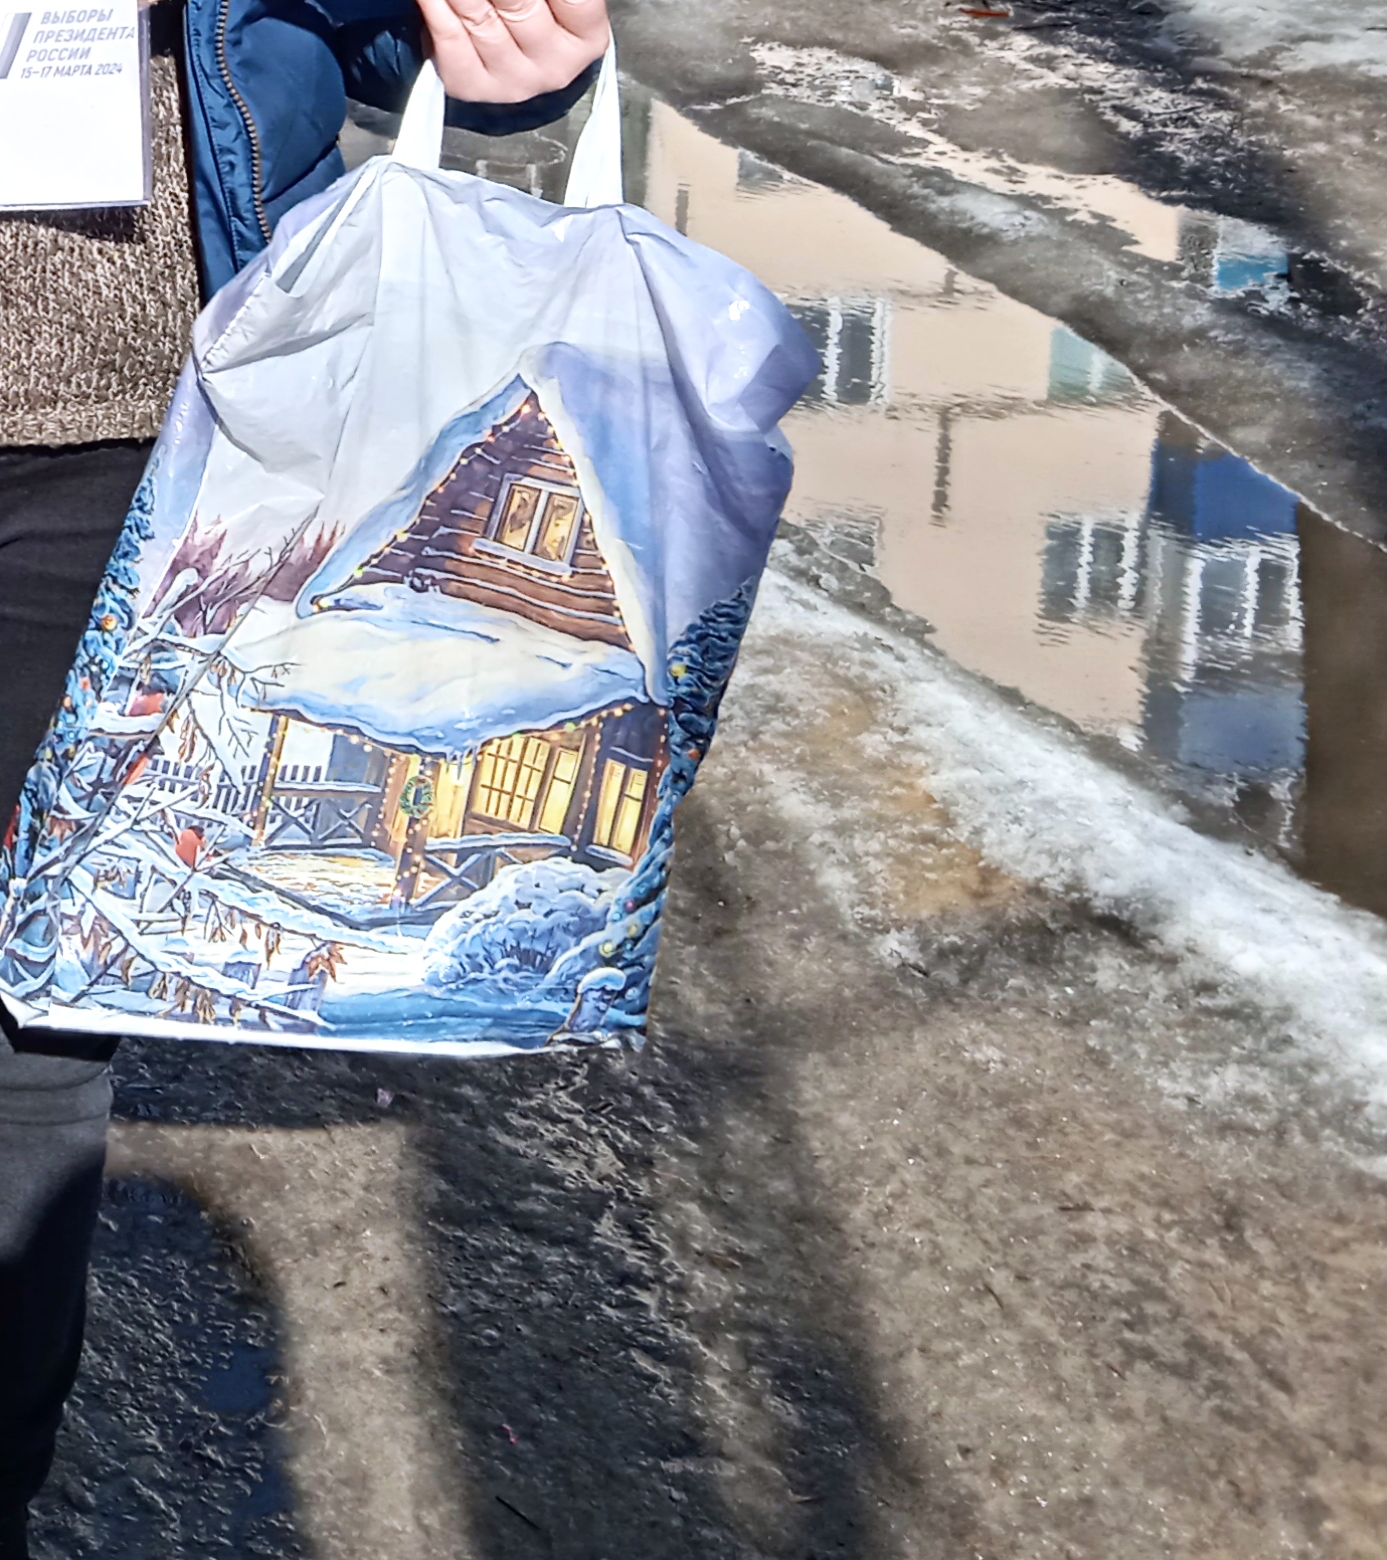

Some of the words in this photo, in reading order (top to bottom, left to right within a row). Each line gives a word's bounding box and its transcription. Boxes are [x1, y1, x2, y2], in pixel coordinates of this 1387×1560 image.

[40, 8, 114, 25] ВЫБОРЫ
[33, 26, 136, 44] ПРЕЗИДЕНТА
[26, 46, 92, 63] РОССИИ
[53, 64, 93, 78] МАРТА
[94, 62, 123, 76] 2024
